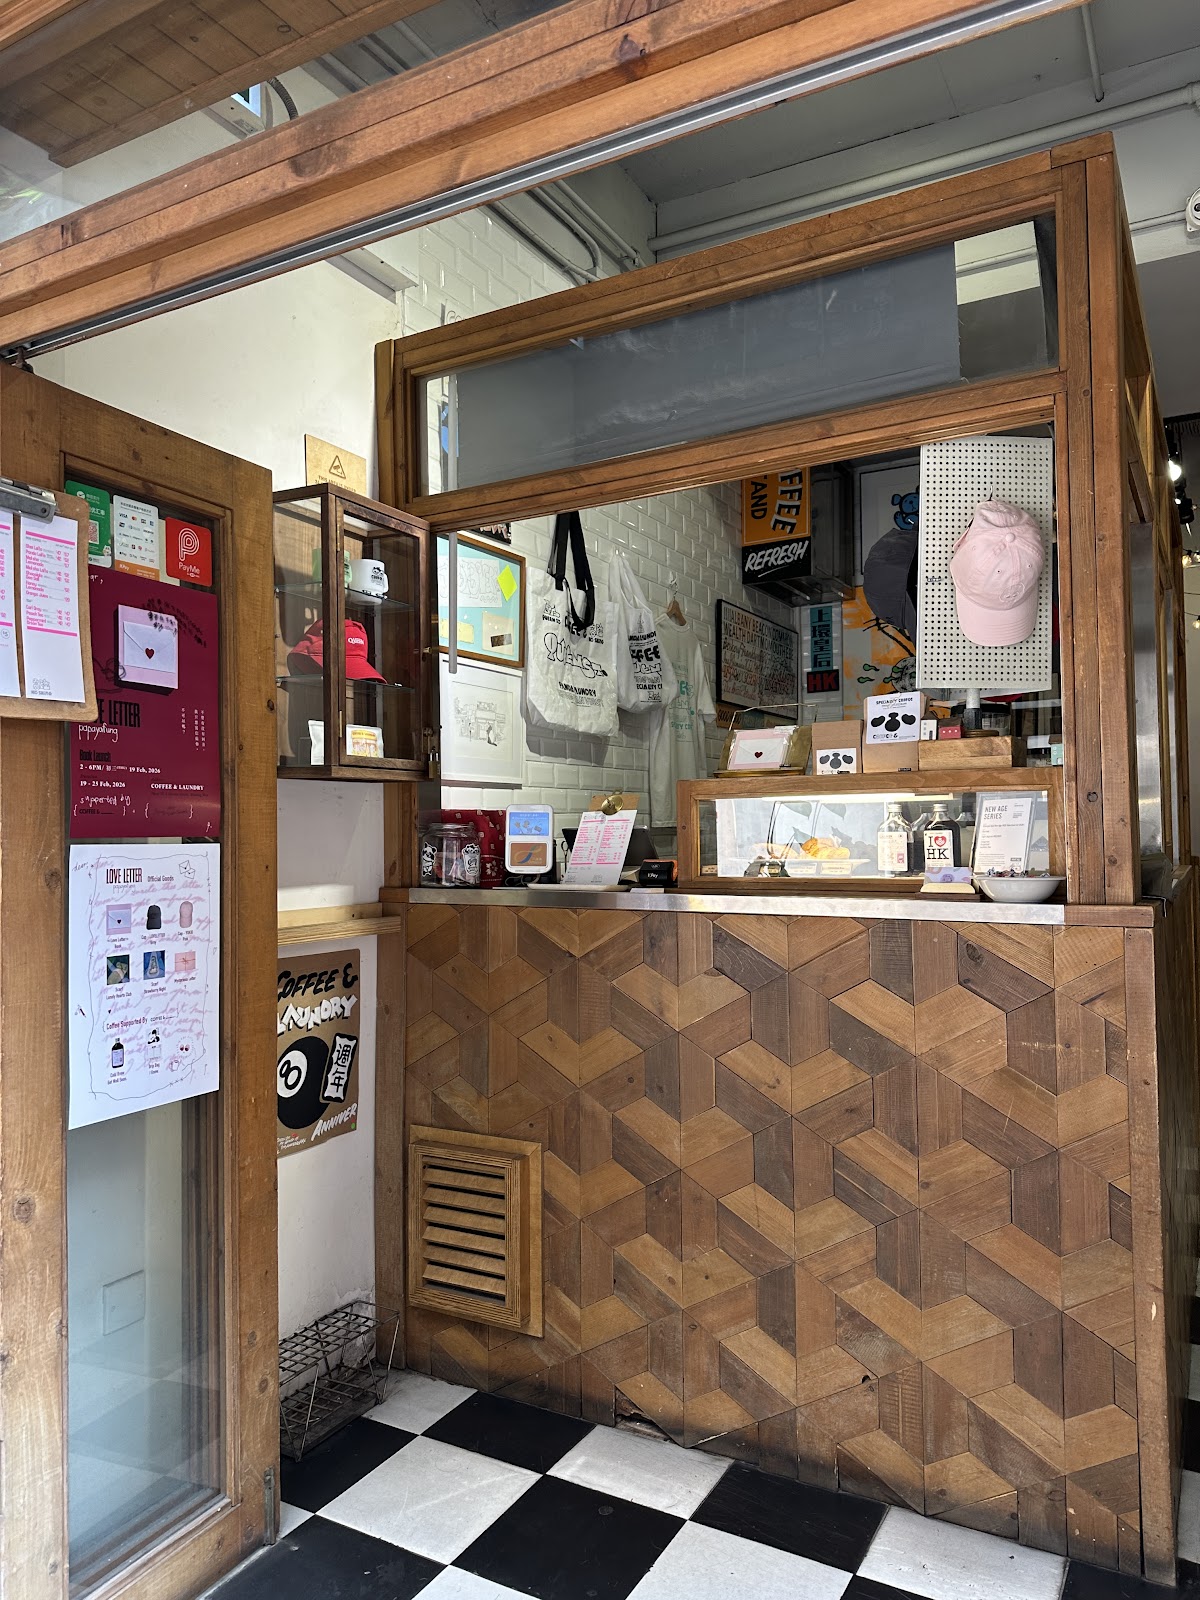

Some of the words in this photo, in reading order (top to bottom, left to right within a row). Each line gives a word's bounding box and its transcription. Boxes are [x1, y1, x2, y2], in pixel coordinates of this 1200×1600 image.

[771, 468, 803, 535] FFEE
[745, 540, 809, 572] REFRESH
[178, 562, 200, 574] PayMe
[810, 609, 833, 669] 上環皇后
[807, 671, 838, 692] HK
[109, 699, 140, 728] LETTER
[80, 749, 92, 761] Book
[120, 794, 131, 806] by
[928, 836, 933, 847] I
[926, 848, 949, 860] HK
[106, 868, 121, 884] LOVE
[123, 867, 142, 883] LETTER
[161, 874, 174, 882] Goods
[342, 963, 359, 989] &
[106, 1021, 120, 1030] Coffee
[120, 1018, 142, 1029] Supported
[142, 1016, 148, 1025] By
[277, 994, 358, 1037] LAUNDRY
[279, 1059, 302, 1090] 8
